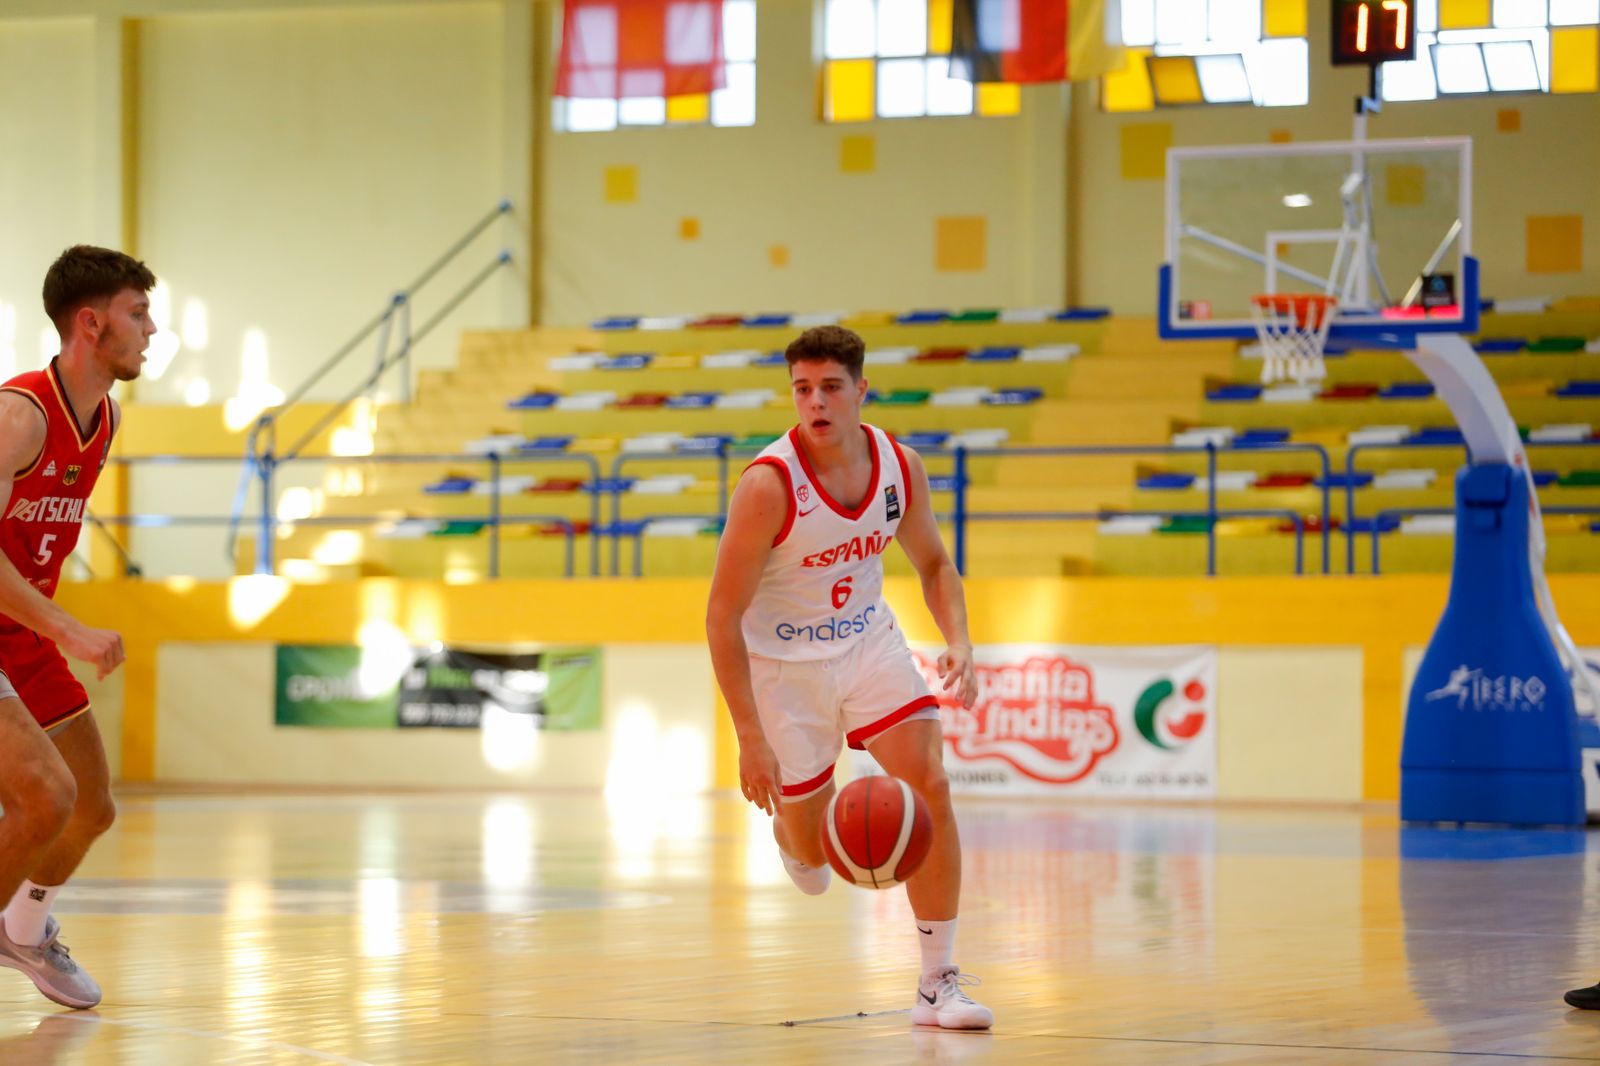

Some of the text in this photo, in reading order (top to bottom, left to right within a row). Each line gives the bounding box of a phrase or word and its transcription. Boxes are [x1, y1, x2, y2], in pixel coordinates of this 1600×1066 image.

[1356, 0, 1407, 52] 17
[33, 533, 57, 566] 5
[831, 576, 853, 609] 6
[982, 702, 1112, 748] Indias
